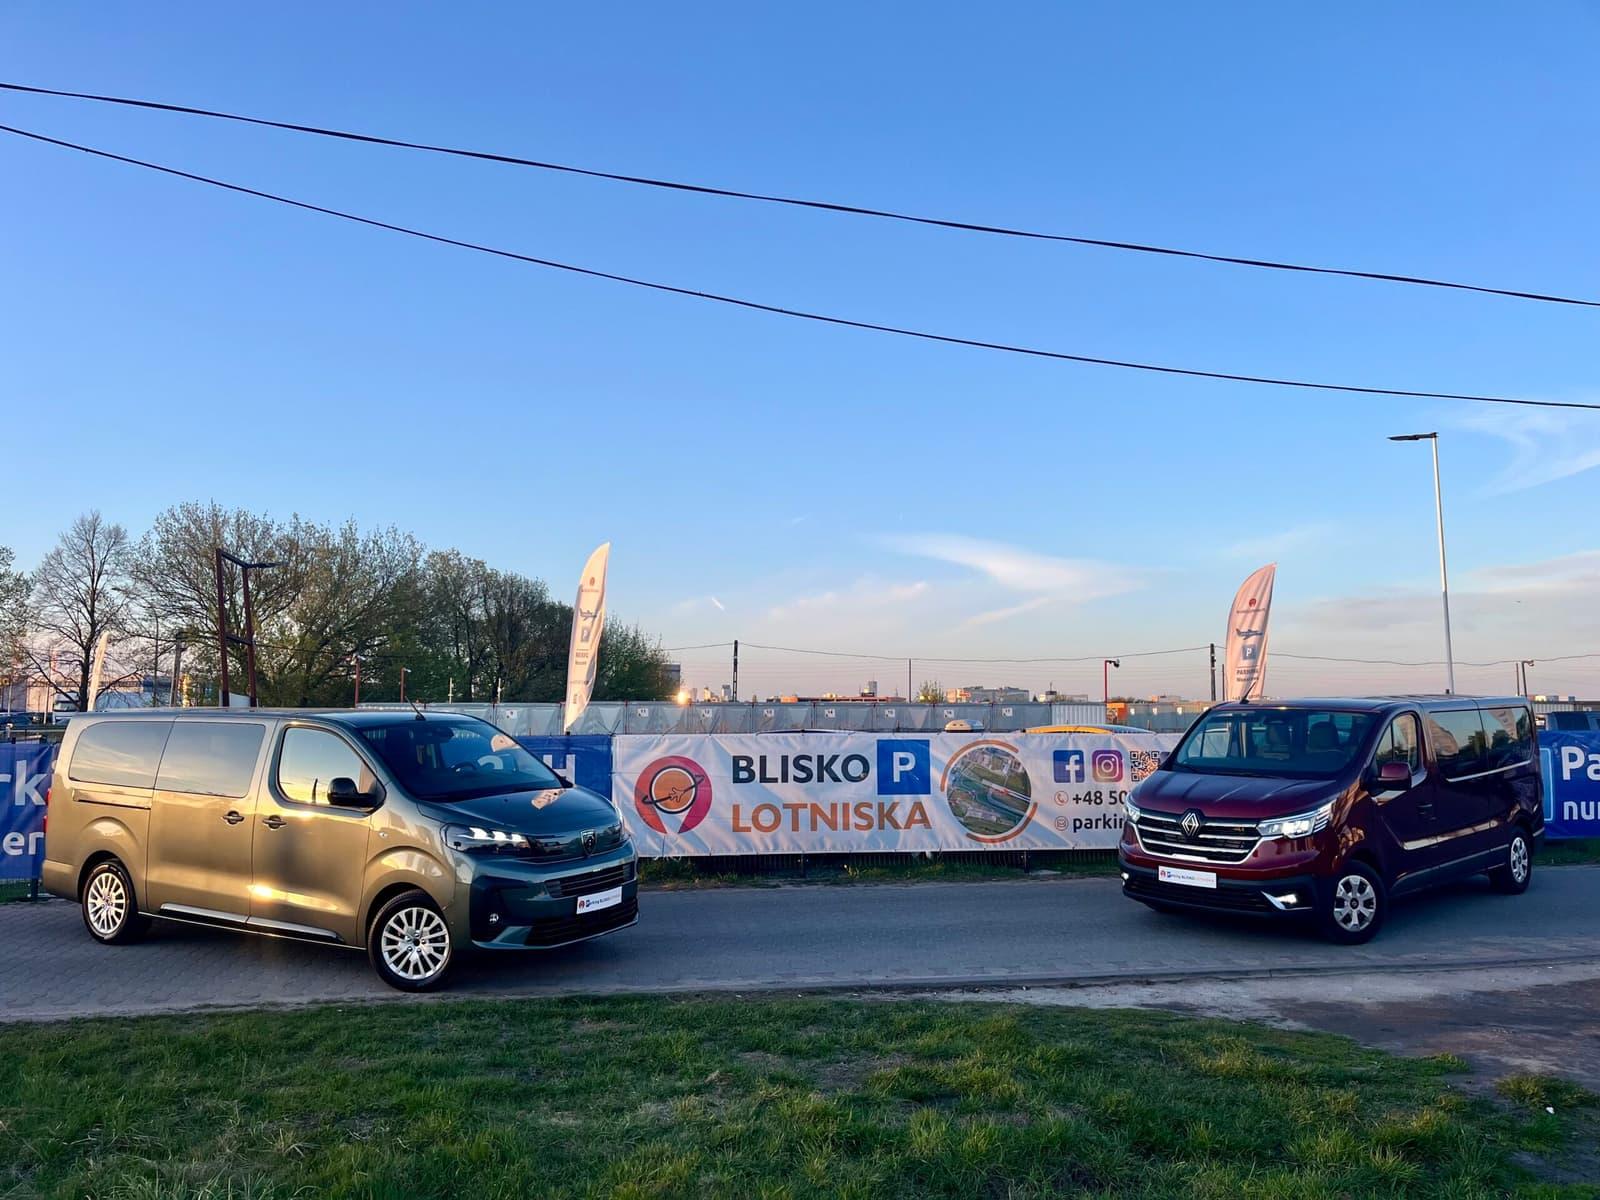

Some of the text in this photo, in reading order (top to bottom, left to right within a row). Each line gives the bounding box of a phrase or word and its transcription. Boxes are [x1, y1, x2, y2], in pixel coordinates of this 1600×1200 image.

[732, 754, 870, 784] BLISKO
[1072, 790, 1103, 806] +48
[732, 801, 932, 833] LOTNISKA
[1563, 801, 1600, 820] nu
